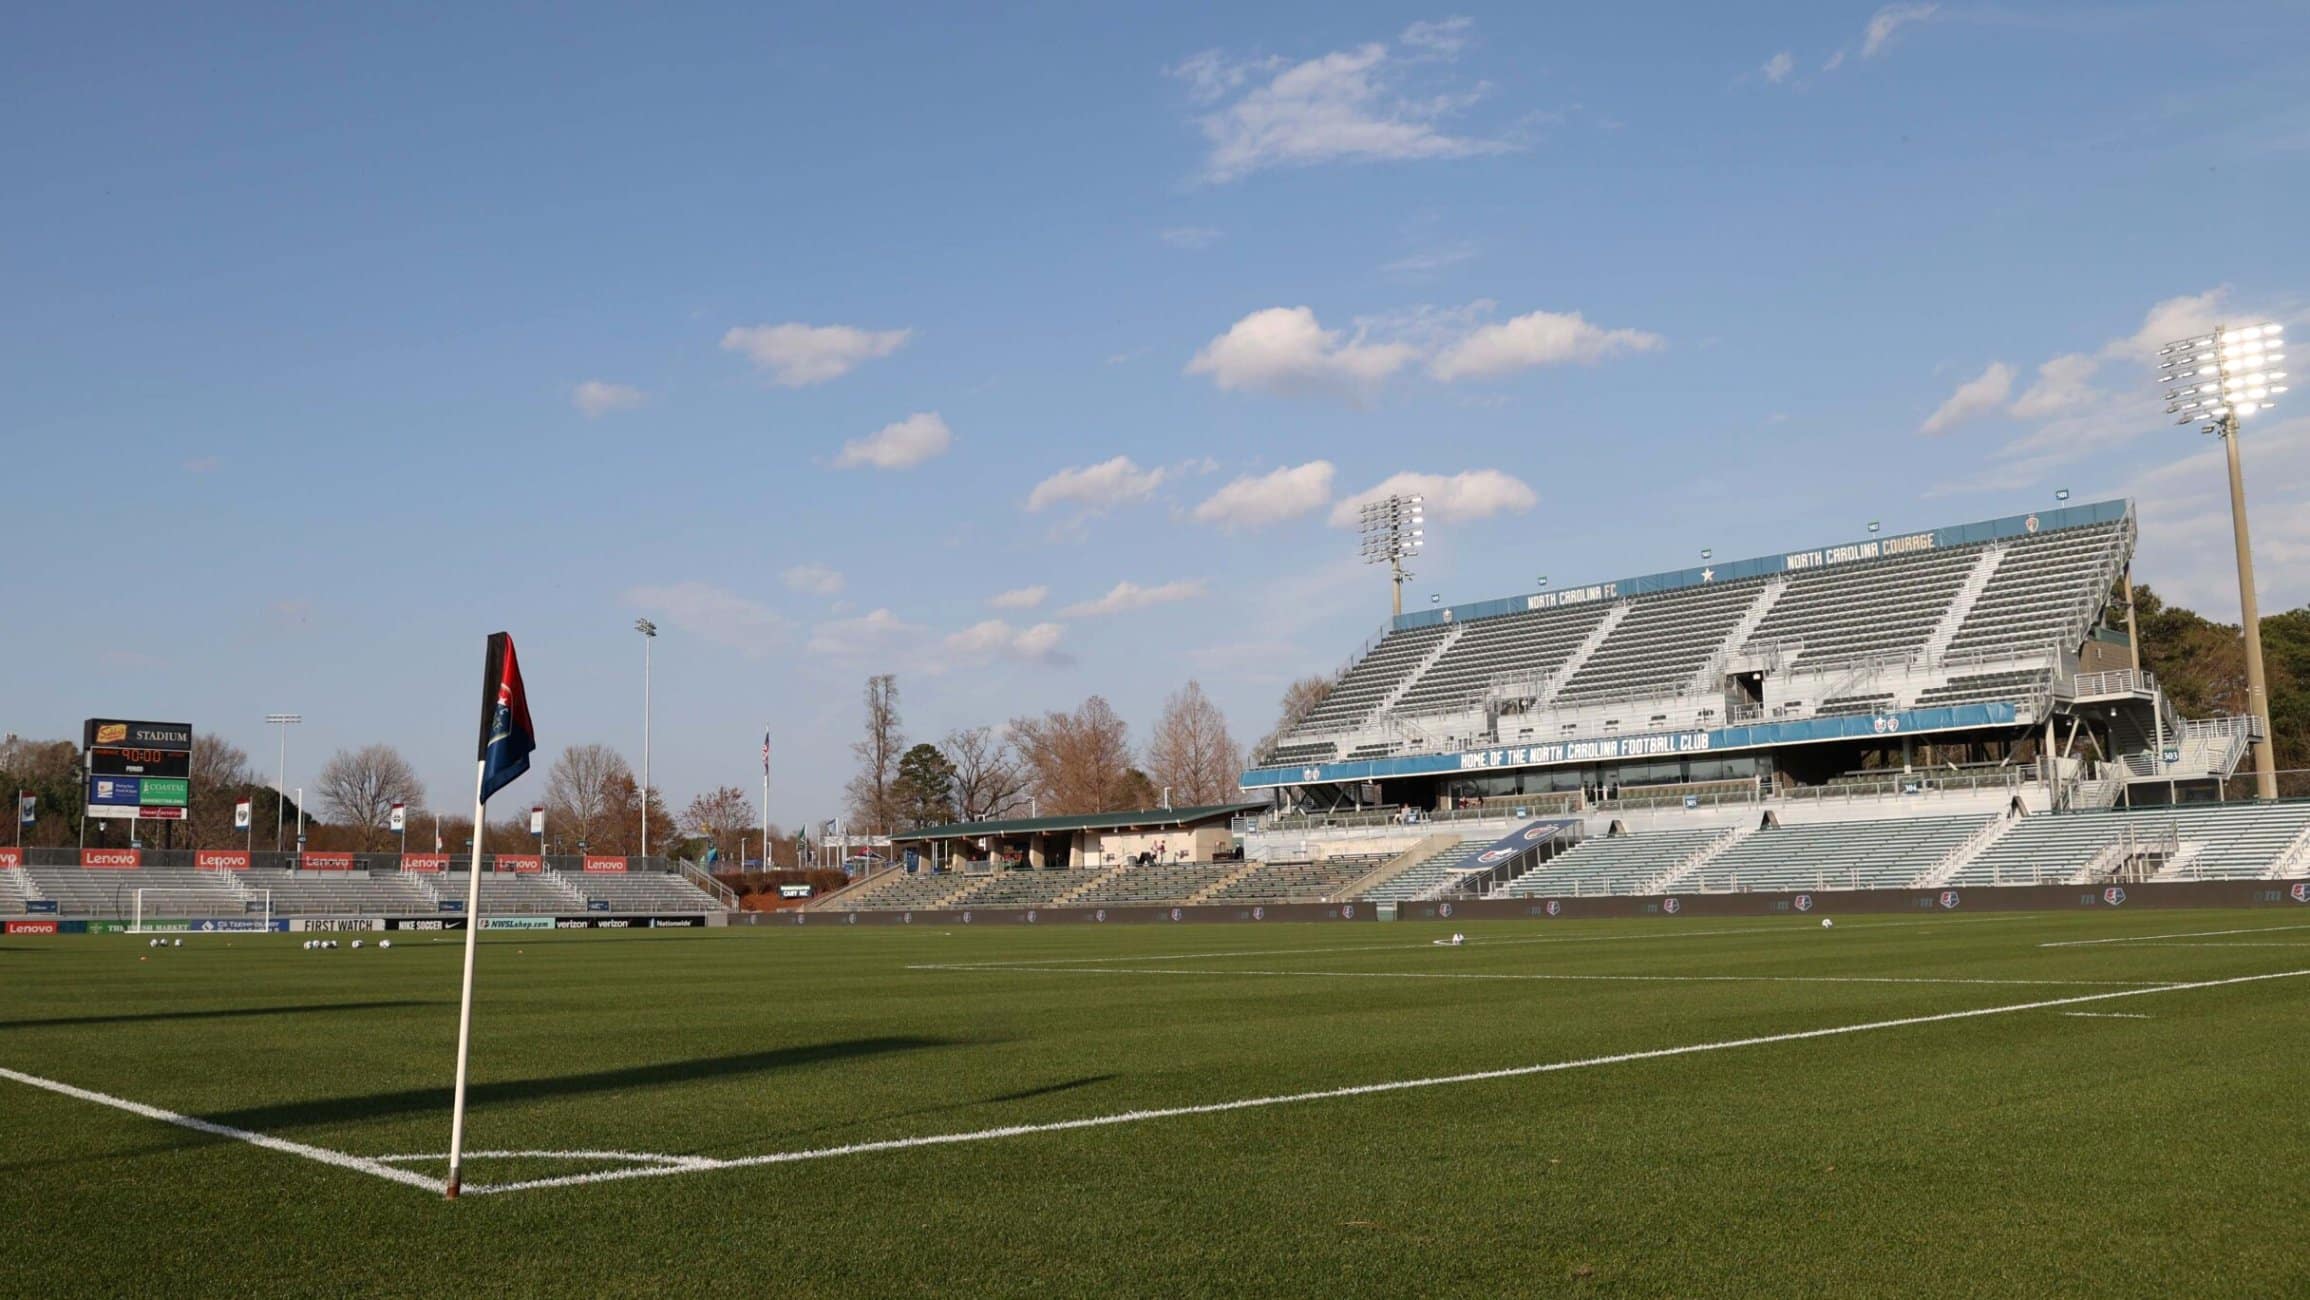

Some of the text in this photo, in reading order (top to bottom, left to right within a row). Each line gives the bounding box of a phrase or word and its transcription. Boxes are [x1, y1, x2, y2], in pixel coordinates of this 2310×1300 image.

[1787, 533, 1935, 570] NORTH CAROLINA COURAGE
[1528, 583, 1617, 610] NORTH CAROLINA FC
[136, 730, 187, 742] STADIUM
[1461, 733, 1709, 768] HOME OF THE NORTH CAROLINA FOOTBALL CLUB
[2164, 751, 2178, 761] 303
[86, 852, 136, 865] Lenovo
[200, 854, 245, 865] Lenovo
[306, 856, 349, 866] Lenovo
[587, 859, 624, 870] Lenovo
[10, 924, 53, 933] Lenovo
[304, 919, 373, 931] FIRST WATCH
[399, 920, 443, 930] NIKE SOCCER
[557, 920, 587, 929] verizon
[598, 919, 628, 928] verizon
